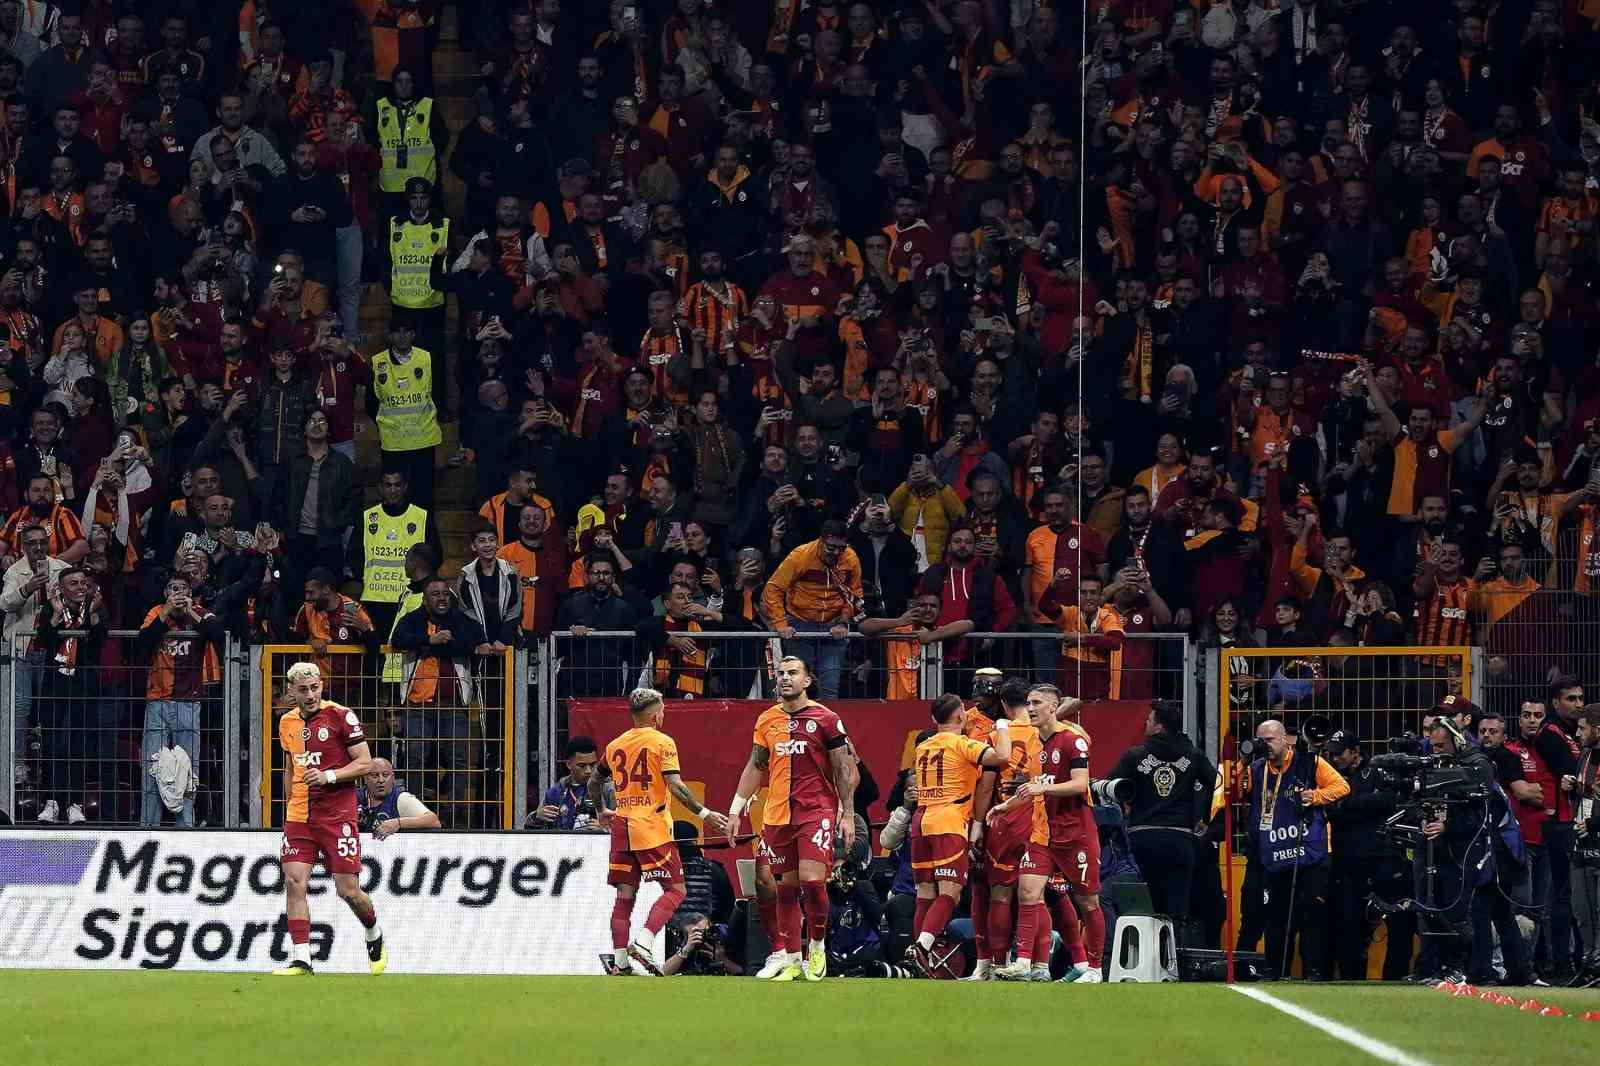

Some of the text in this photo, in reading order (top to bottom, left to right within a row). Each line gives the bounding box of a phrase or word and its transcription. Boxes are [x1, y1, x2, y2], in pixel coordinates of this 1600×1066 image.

[611, 747, 653, 792] 34
[918, 749, 945, 788] 11
[336, 837, 358, 858] 53
[811, 828, 832, 850] 42
[1273, 846, 1306, 862] PRESS
[1079, 863, 1088, 882] 7
